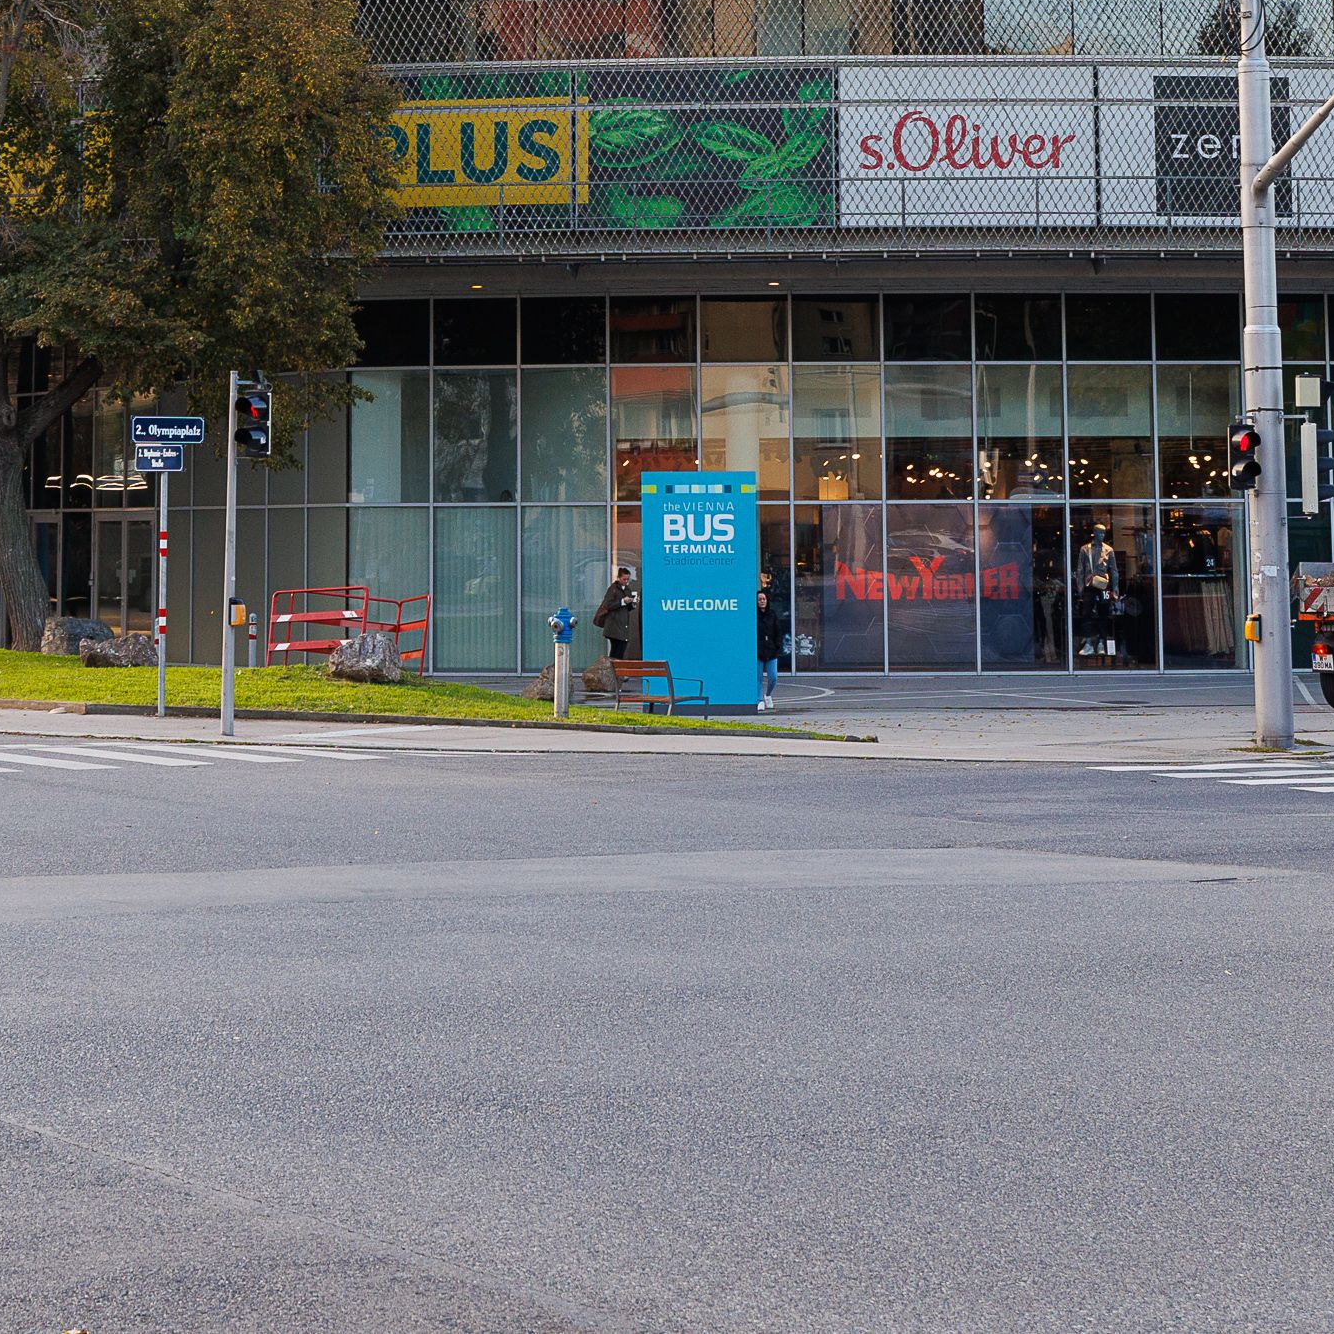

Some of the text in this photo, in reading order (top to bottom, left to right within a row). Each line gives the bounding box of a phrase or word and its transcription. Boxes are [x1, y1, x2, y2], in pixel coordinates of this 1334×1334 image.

[859, 110, 1076, 172] s.Oliver
[1171, 133, 1257, 160] zer
[148, 424, 201, 439] Olympiaplatz
[663, 501, 735, 512] the VIENNA
[663, 514, 735, 541] BUS
[664, 544, 735, 554] TERMINAL
[664, 556, 735, 566] StadionCenter
[661, 598, 738, 611] WELCOME
